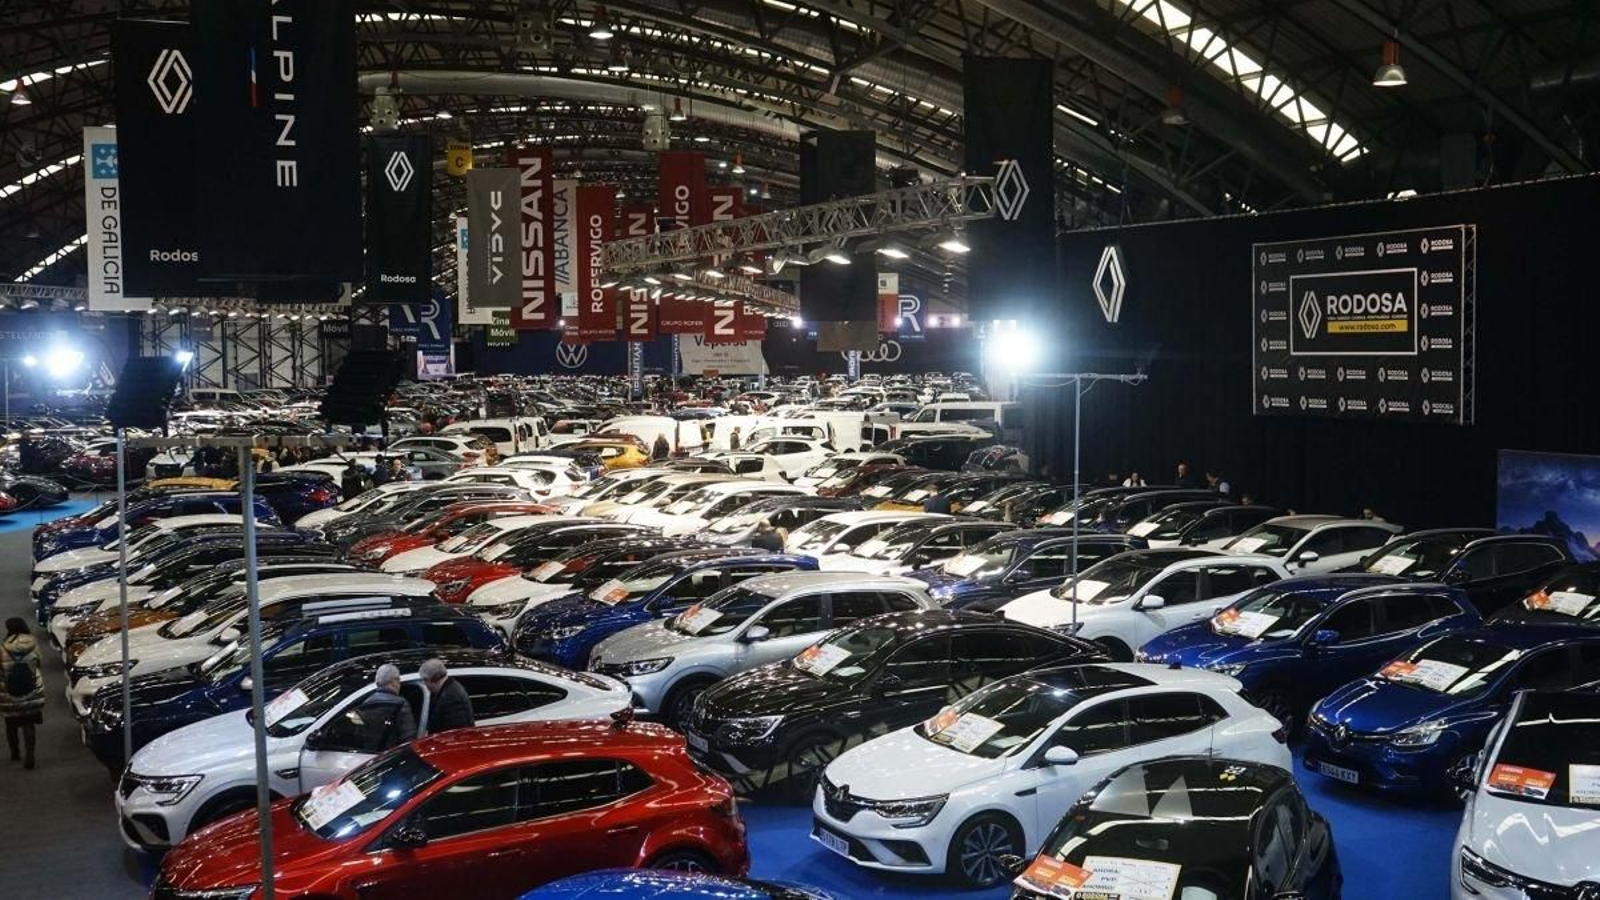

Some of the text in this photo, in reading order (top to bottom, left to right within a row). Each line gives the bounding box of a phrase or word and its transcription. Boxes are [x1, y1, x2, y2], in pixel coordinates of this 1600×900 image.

[271, 0, 299, 188] LPINE
[455, 156, 464, 168] C
[101, 187, 120, 294] DE GALICIA
[518, 156, 545, 320] NISSAN
[150, 249, 199, 262] Rodos
[380, 273, 417, 284] Rodosa
[1327, 292, 1408, 315] RODOSA
[323, 323, 348, 333] Móvil
[491, 328, 515, 337] Móvil
[1338, 322, 1396, 331] www.rodosa.com
[633, 342, 643, 392] HYUNDAI
